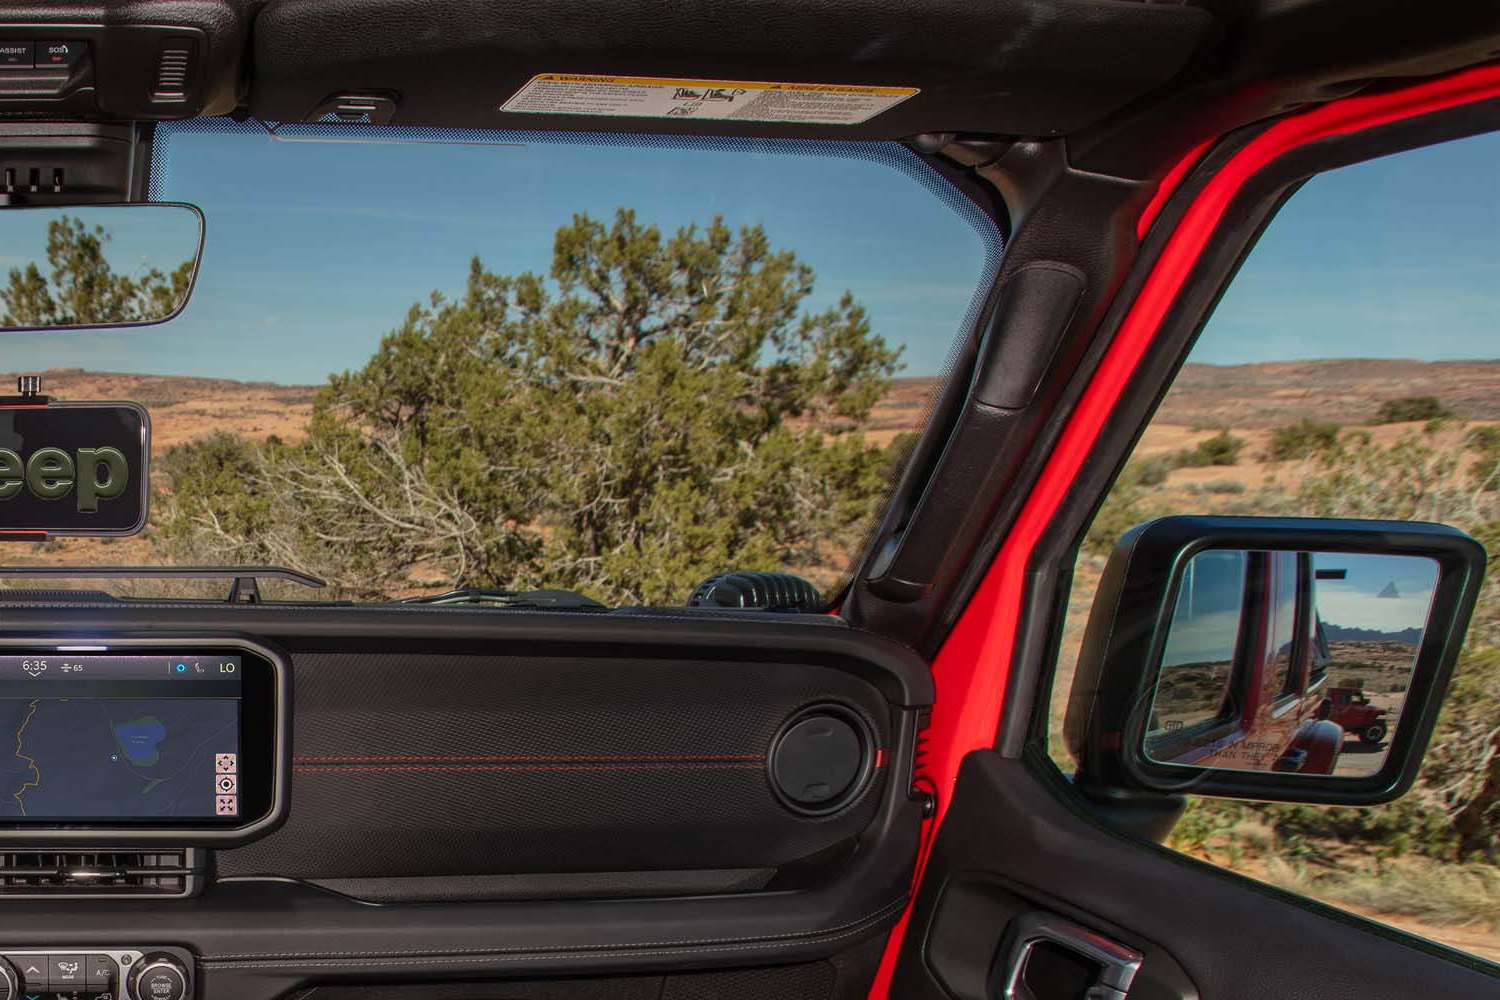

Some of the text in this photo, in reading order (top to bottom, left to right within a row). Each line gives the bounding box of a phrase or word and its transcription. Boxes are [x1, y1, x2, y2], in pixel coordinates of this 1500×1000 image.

[49, 46, 64, 54] SOS
[22, 660, 47, 671] 6:35
[73, 664, 83, 672] 65
[219, 662, 235, 673] LO
